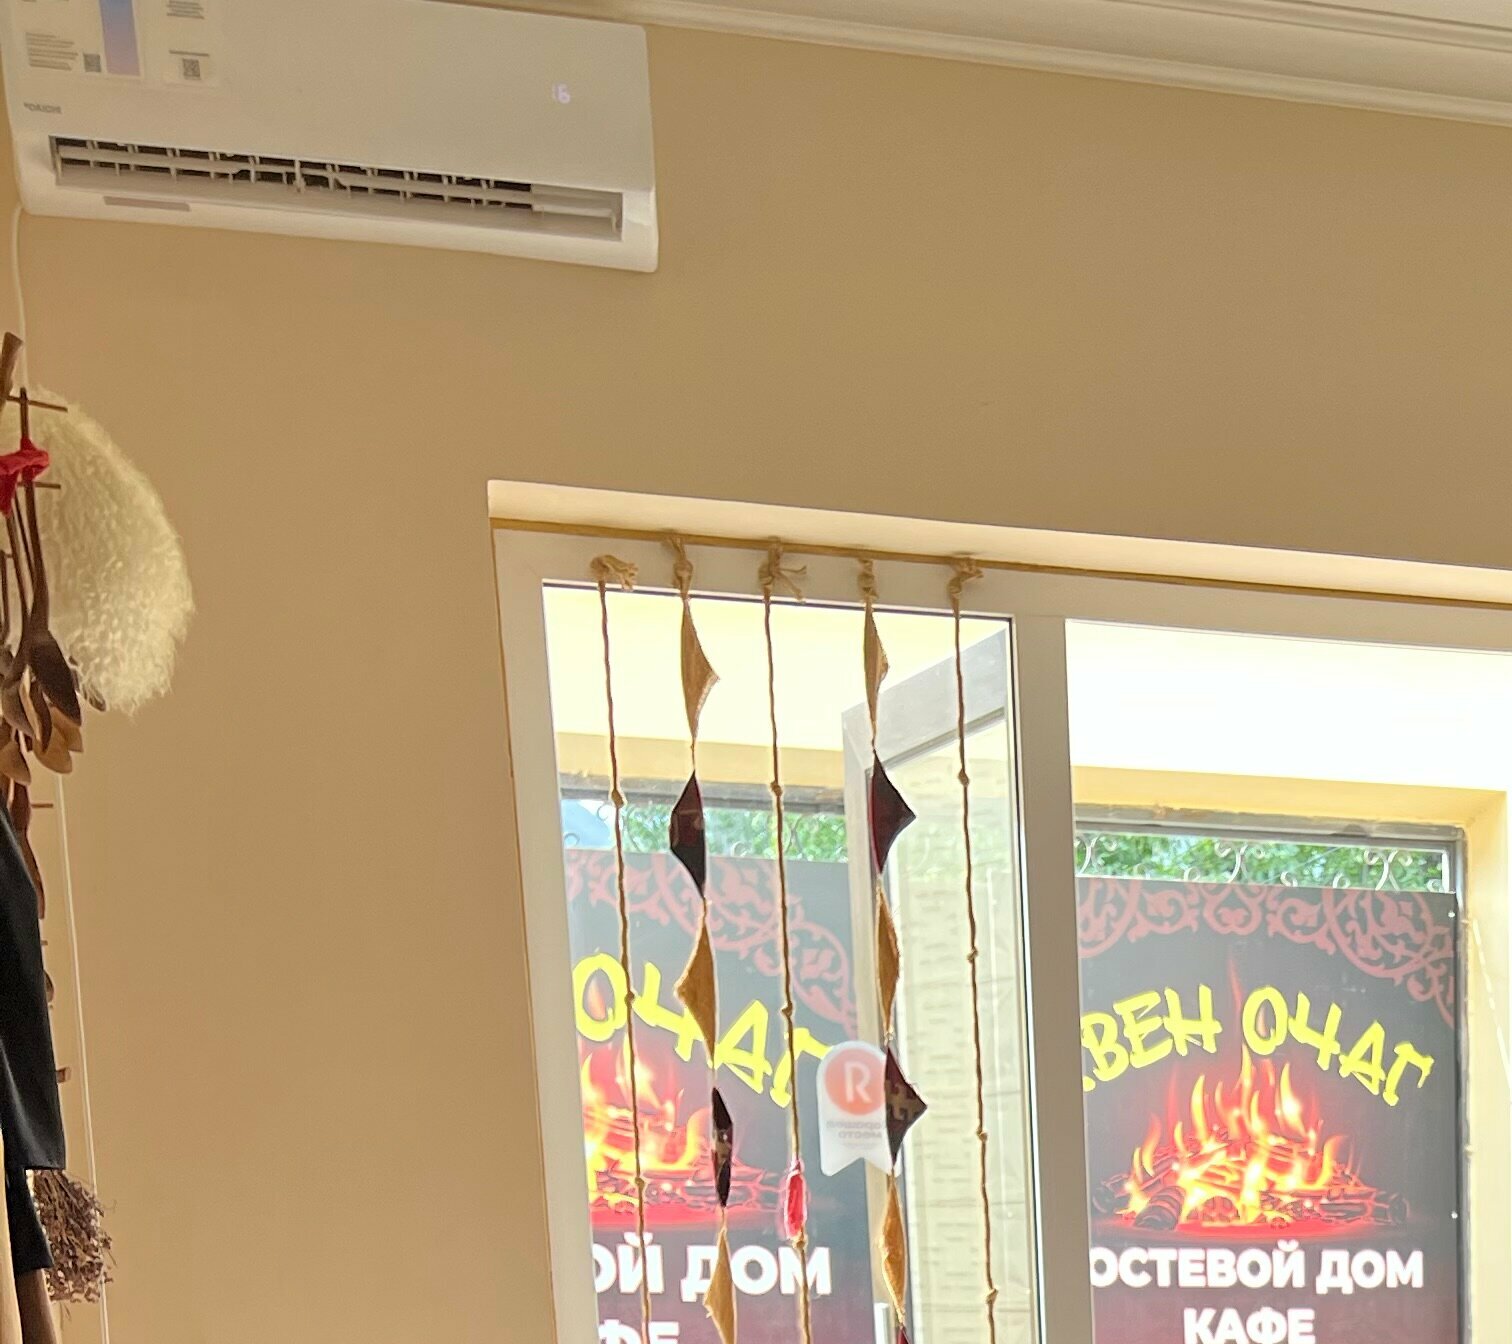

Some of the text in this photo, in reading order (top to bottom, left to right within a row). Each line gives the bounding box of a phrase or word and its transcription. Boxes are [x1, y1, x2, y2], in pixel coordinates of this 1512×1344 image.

[571, 952, 833, 1108] ОЧАГ
[1080, 984, 1435, 1107] ВЕН ОЧАГ
[1315, 1249, 1424, 1295] ДОМ
